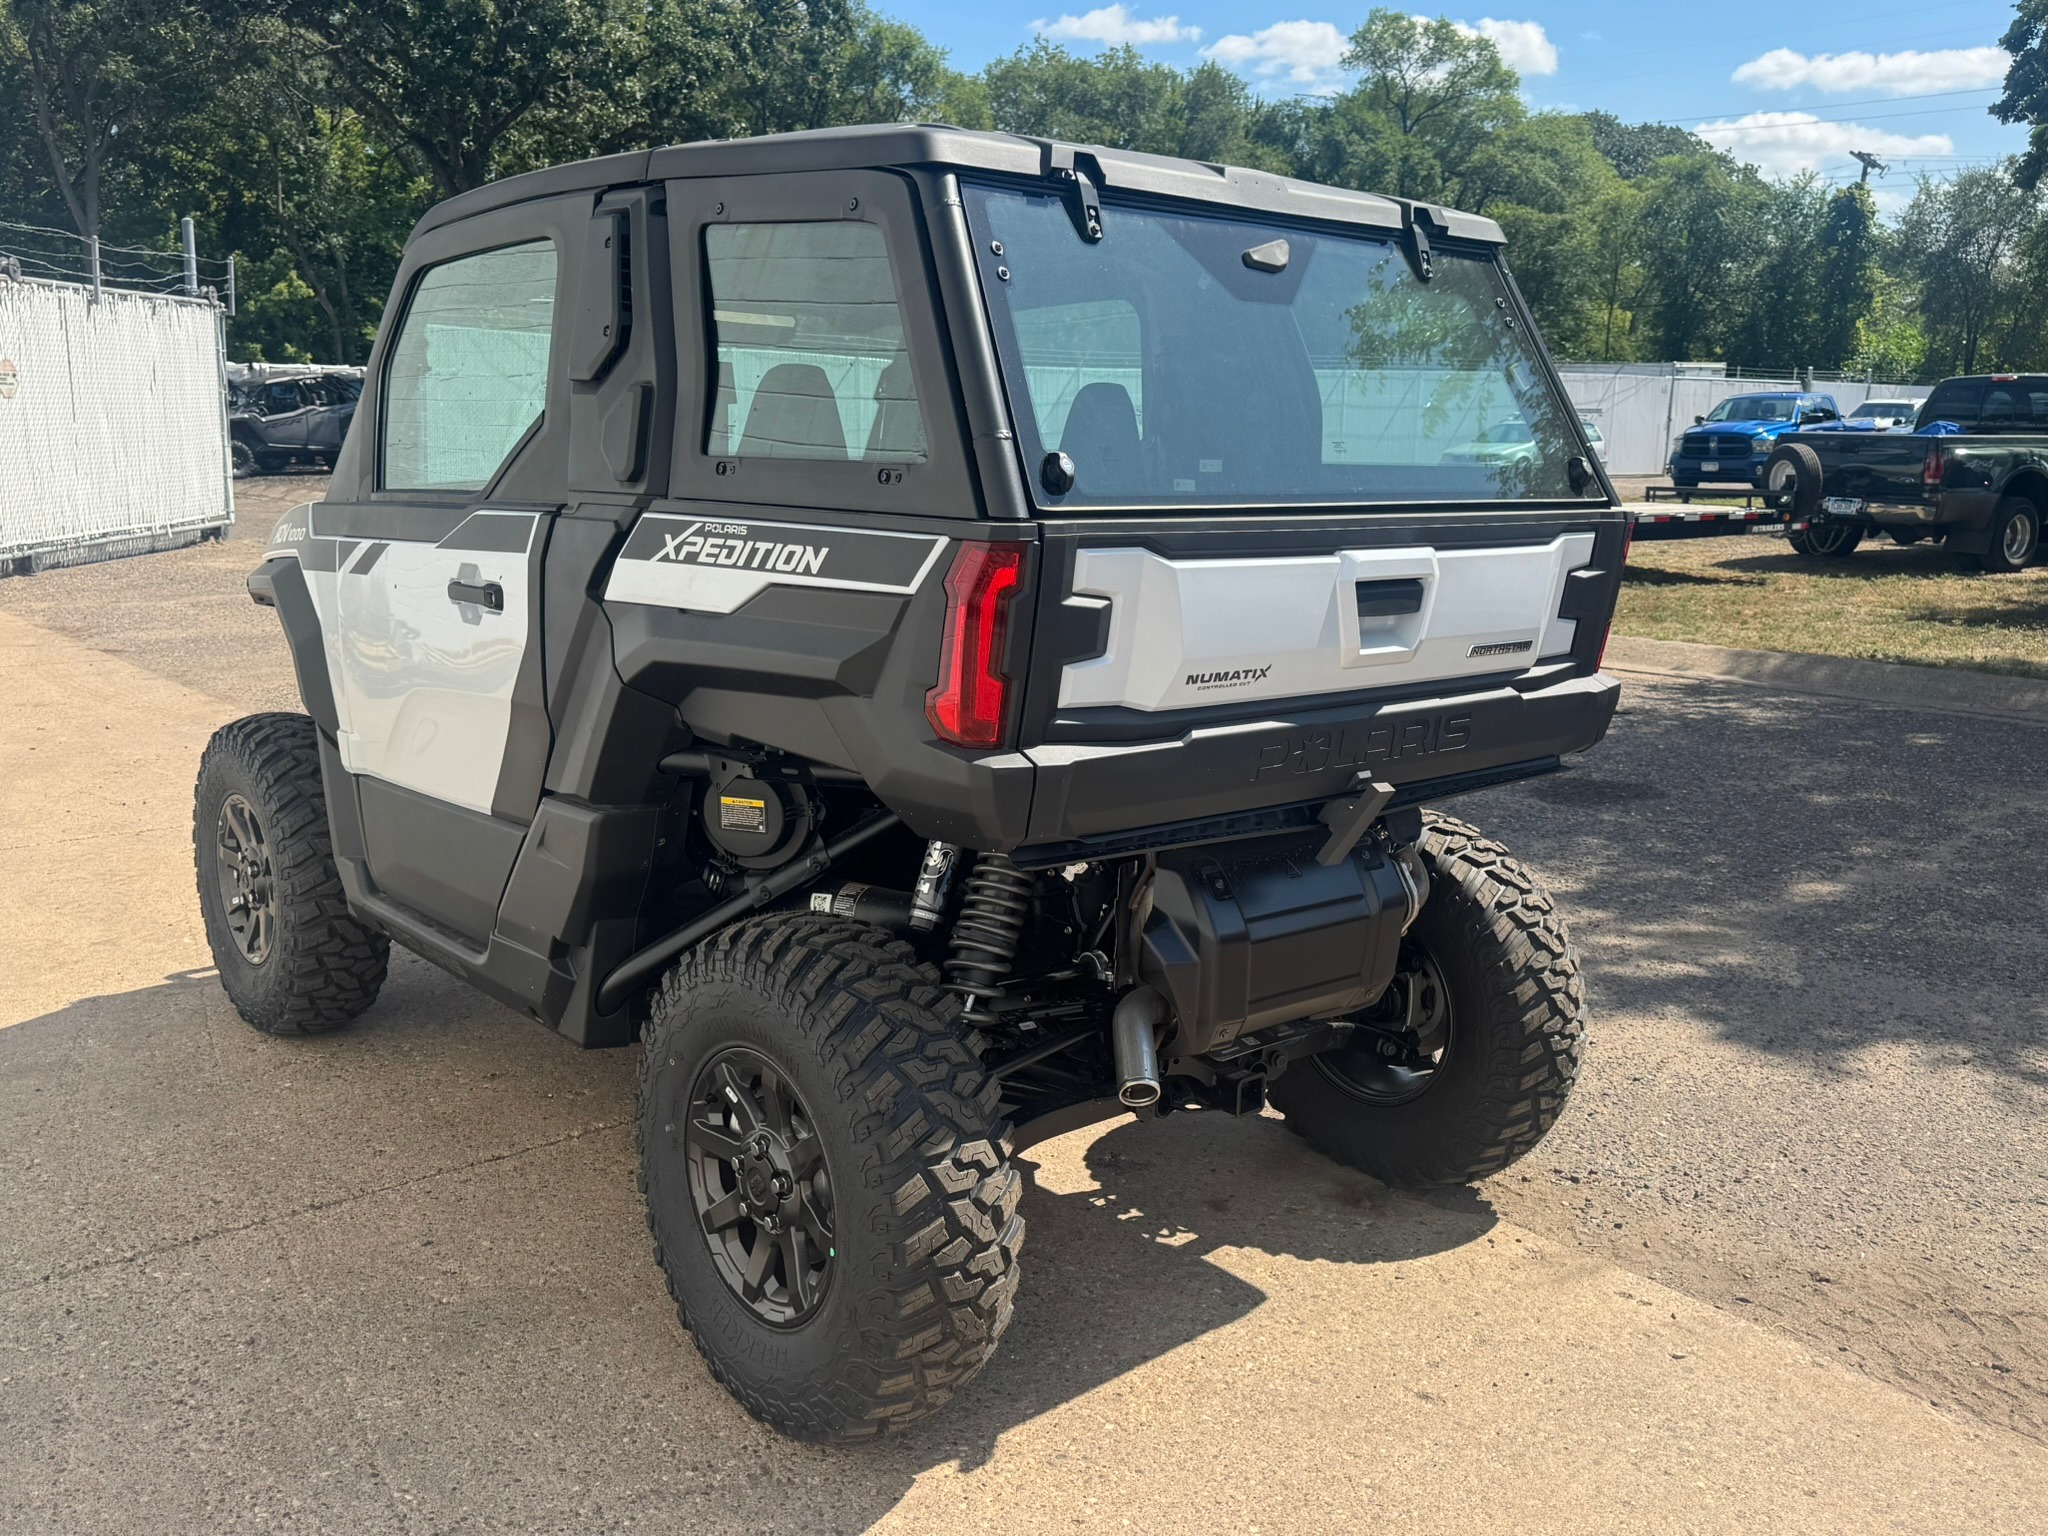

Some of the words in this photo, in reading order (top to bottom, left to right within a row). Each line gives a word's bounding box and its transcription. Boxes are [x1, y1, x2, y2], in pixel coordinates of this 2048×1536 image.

[704, 523, 748, 536] POLARIS
[650, 522, 830, 575] XPEDITION
[1470, 642, 1532, 657] NORTHSTAR
[1185, 663, 1272, 686] NUMATIX
[1197, 682, 1237, 691] CONTROLLED
[1250, 712, 1472, 782] POLARIS
